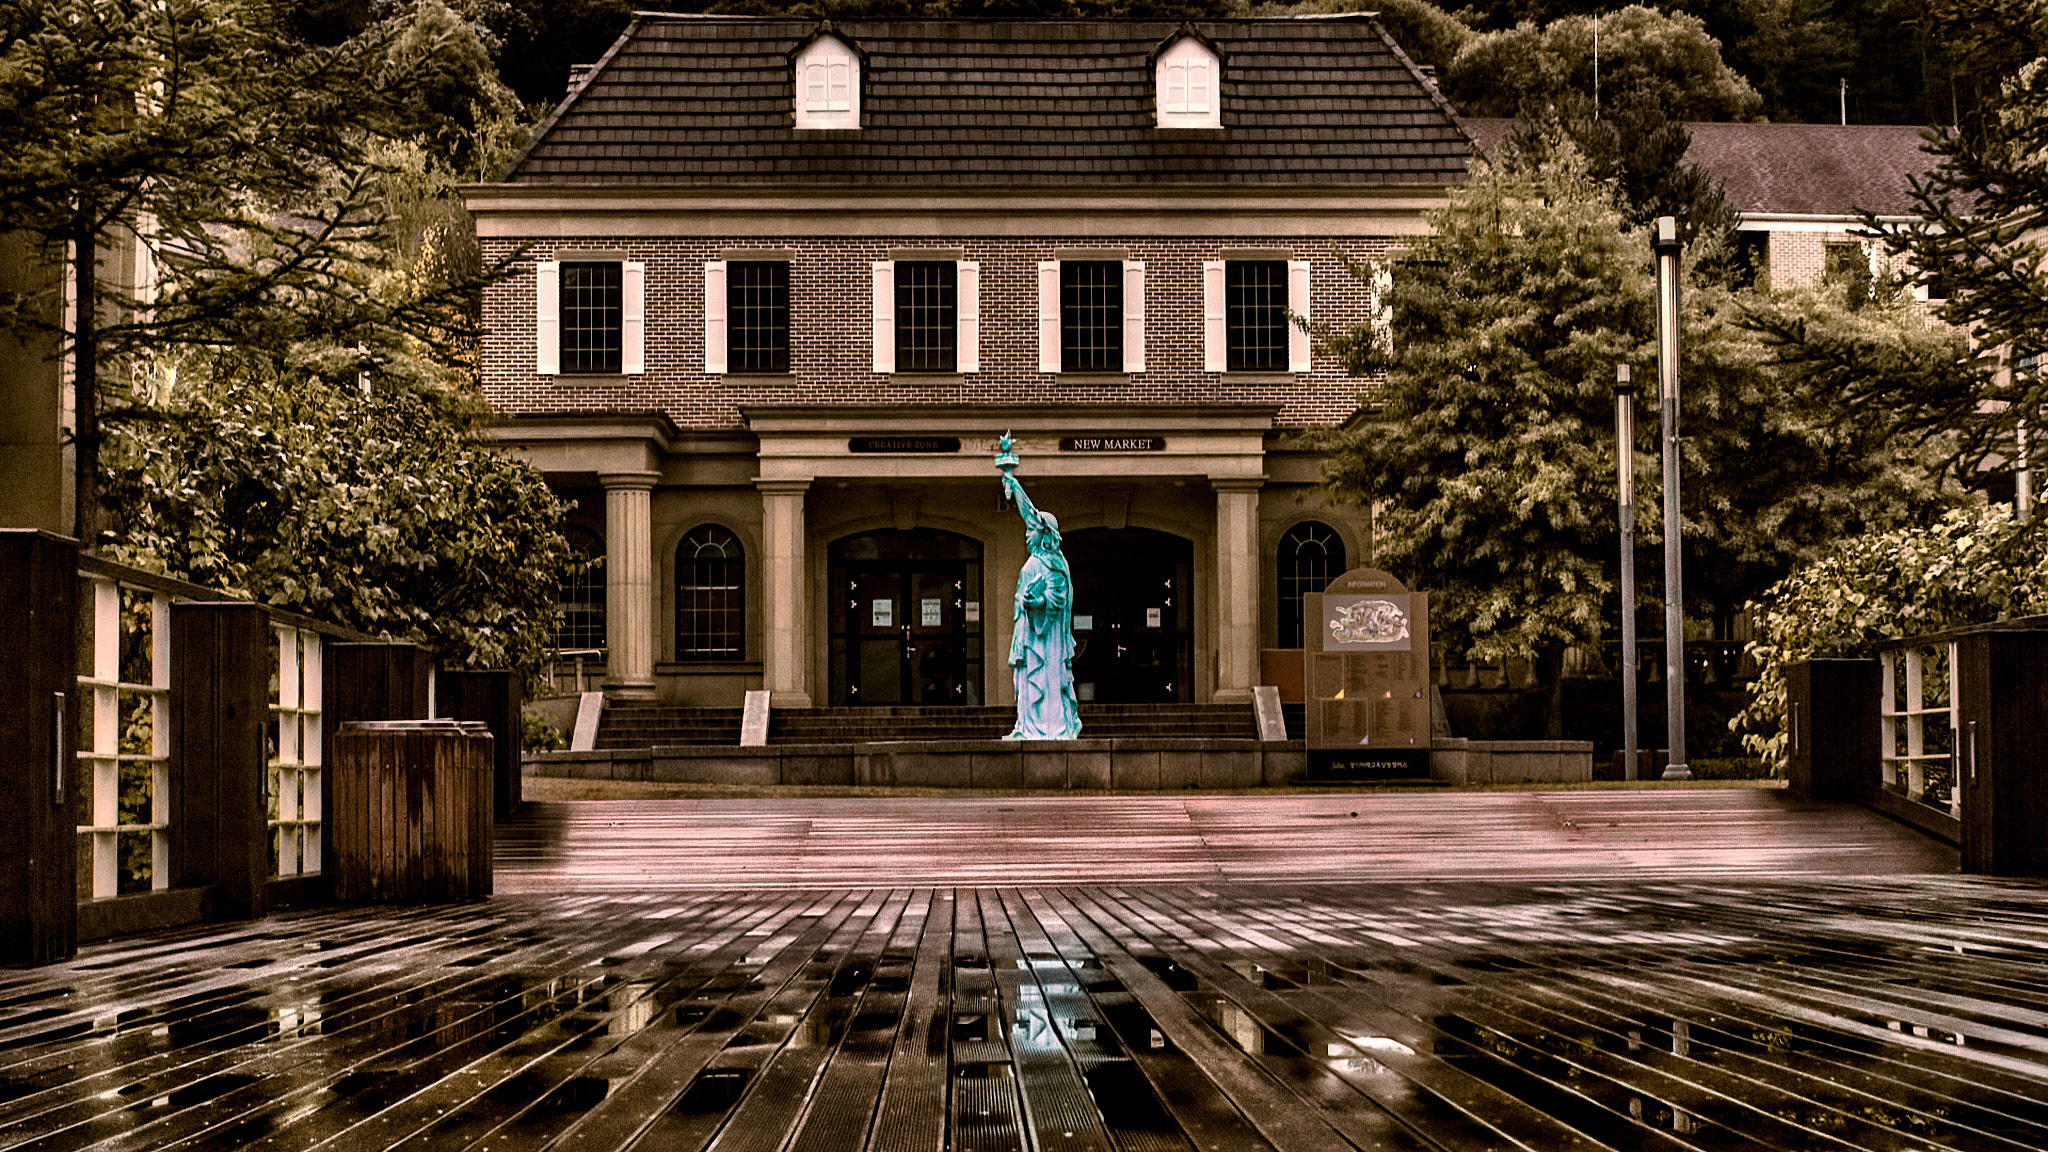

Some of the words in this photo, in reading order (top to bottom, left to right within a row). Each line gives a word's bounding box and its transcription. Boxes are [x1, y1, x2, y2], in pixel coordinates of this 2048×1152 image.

[868, 440, 912, 449] CREATIVE
[914, 440, 939, 449] ZONE
[1074, 439, 1100, 450] NEW
[1104, 439, 1152, 450] MARKET
[1347, 580, 1387, 588] INFORMATION
